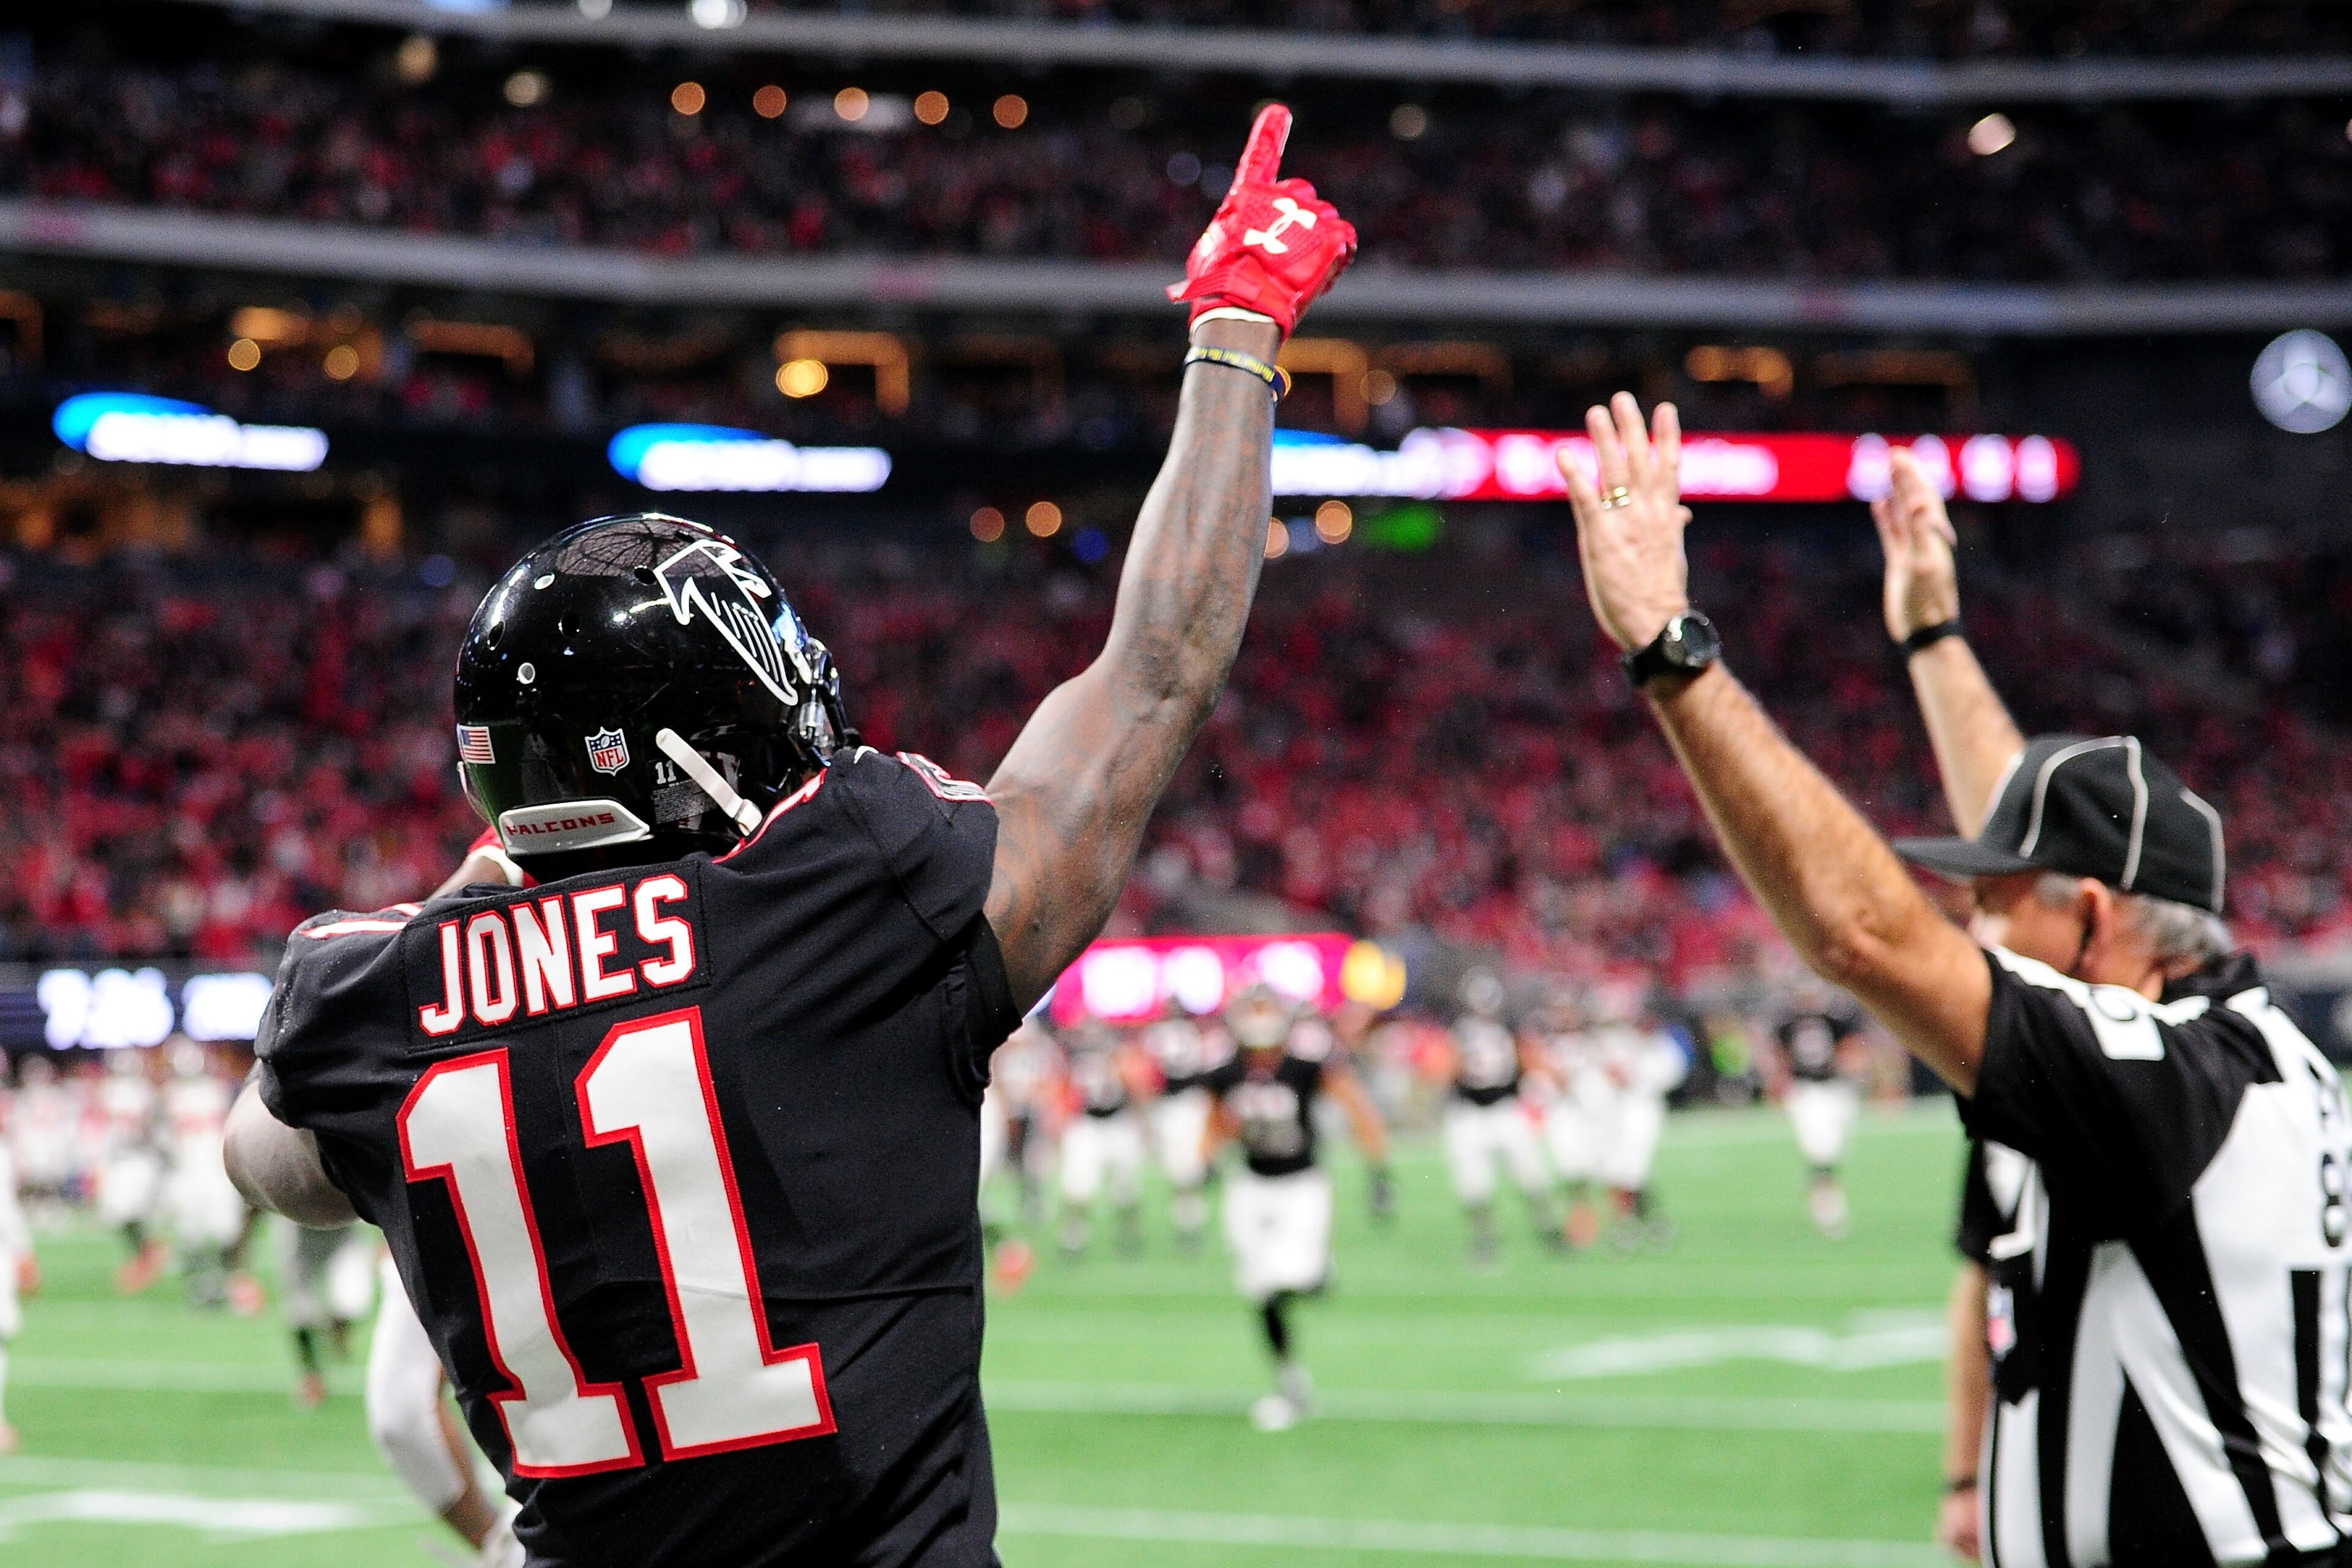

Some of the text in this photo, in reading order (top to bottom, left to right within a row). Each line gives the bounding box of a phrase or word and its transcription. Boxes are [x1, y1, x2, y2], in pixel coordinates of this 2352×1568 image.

[595, 747, 624, 767] NFL
[655, 760, 677, 785] 11
[506, 812, 616, 835] FALCONS
[419, 873, 696, 1036] JONES
[396, 1005, 837, 1479] 11
